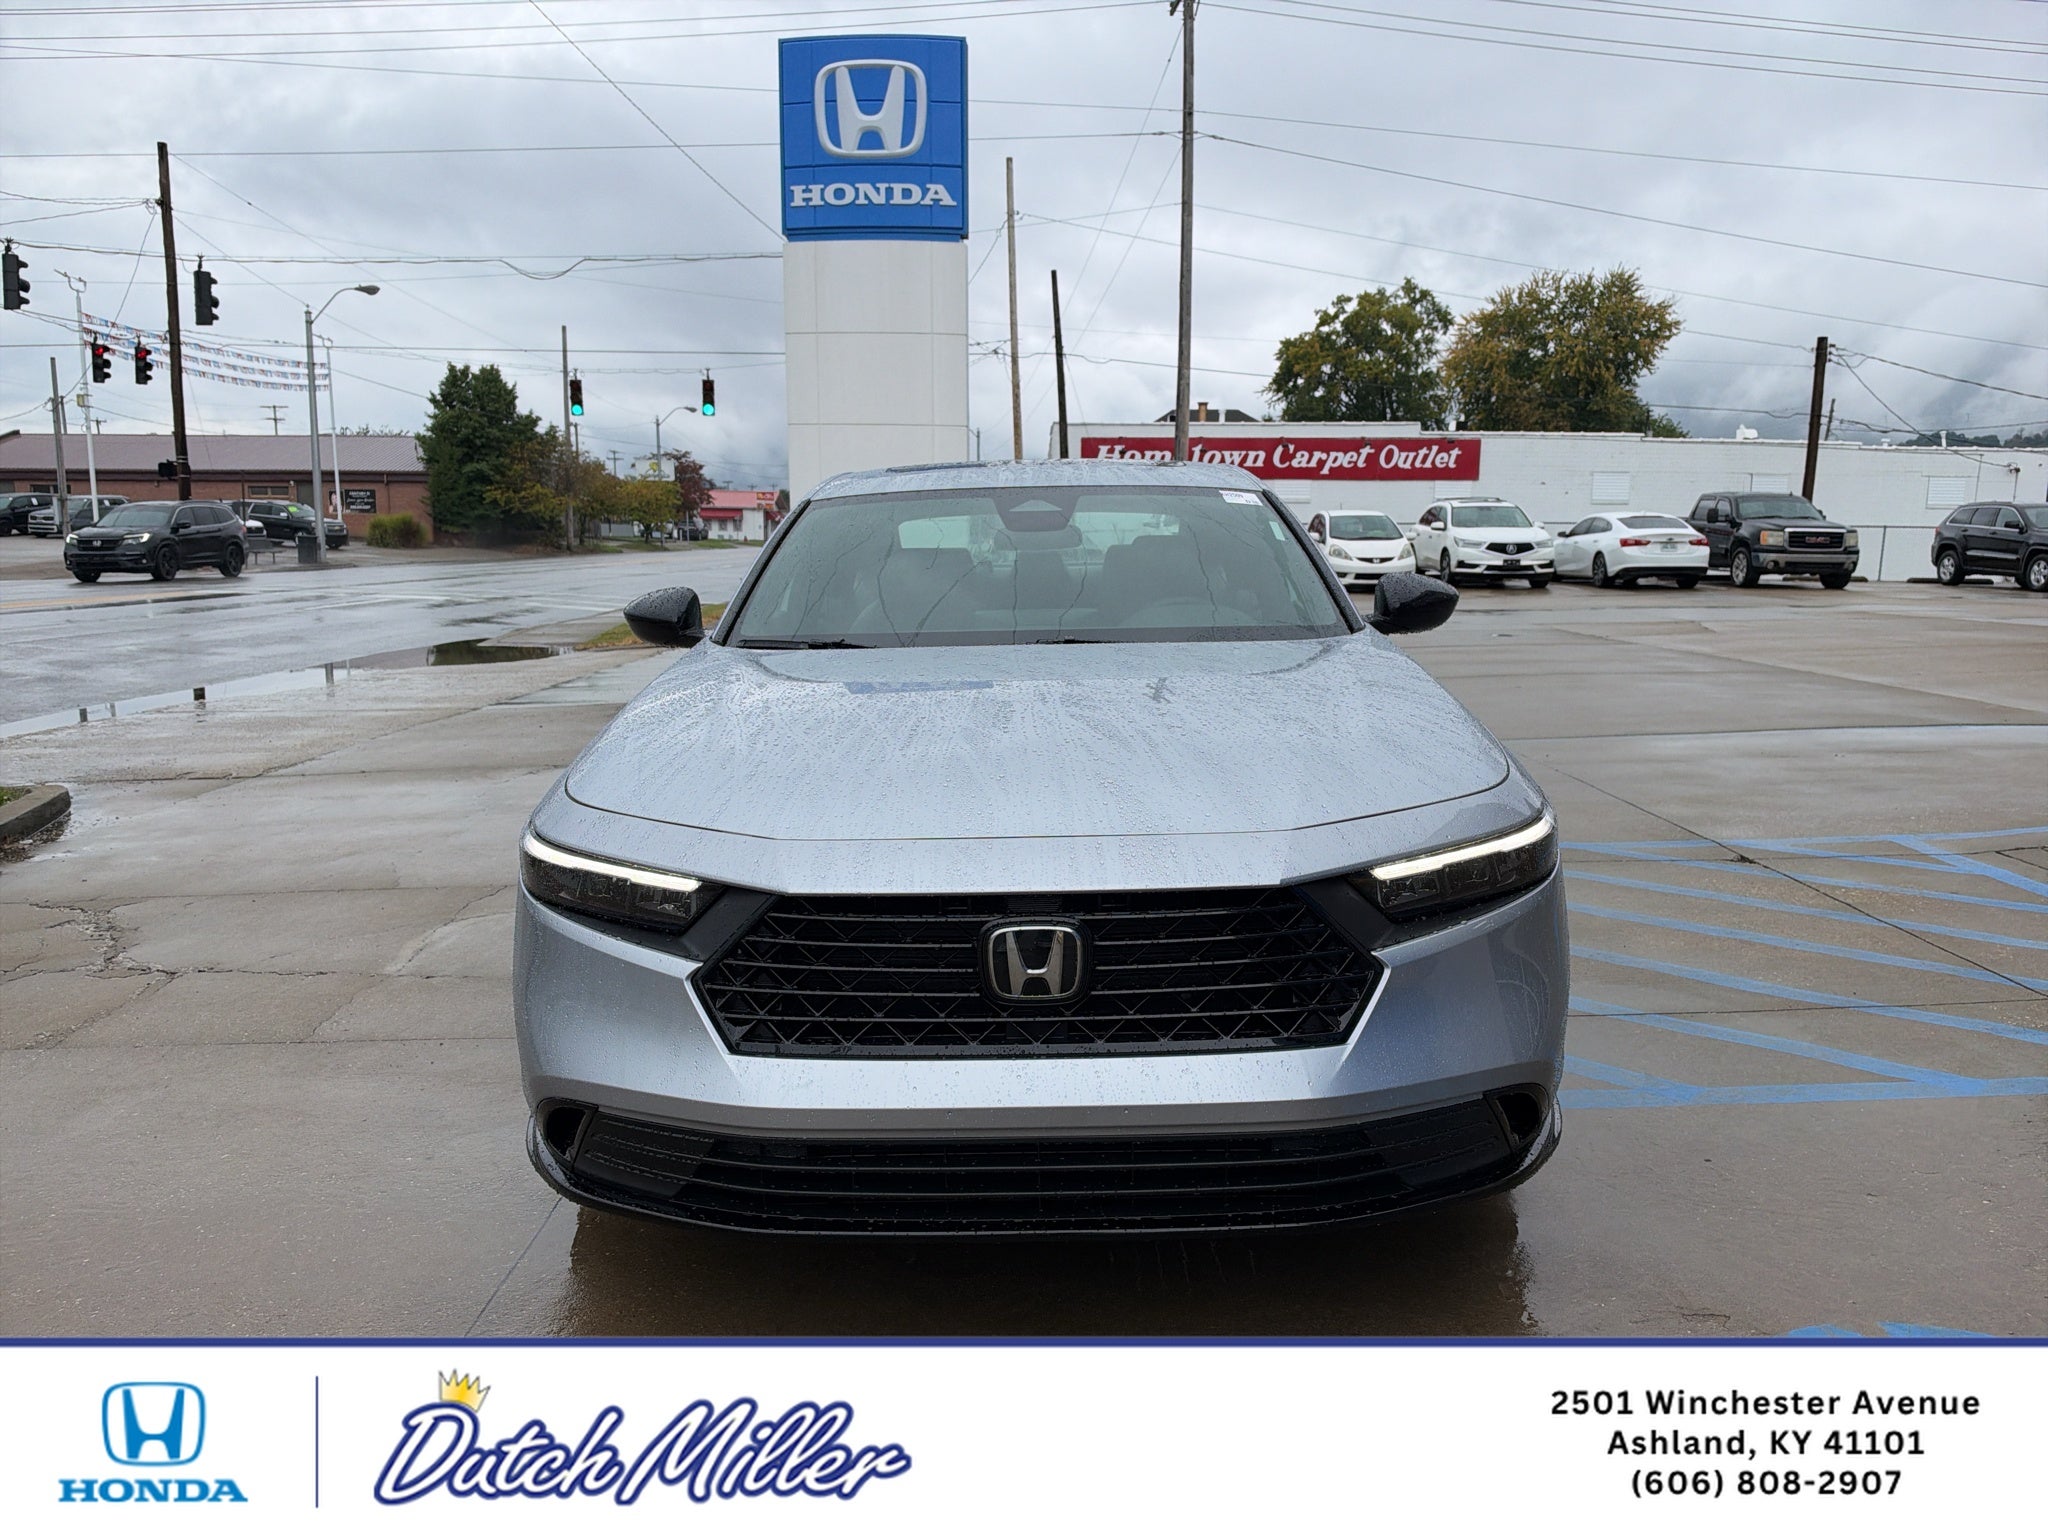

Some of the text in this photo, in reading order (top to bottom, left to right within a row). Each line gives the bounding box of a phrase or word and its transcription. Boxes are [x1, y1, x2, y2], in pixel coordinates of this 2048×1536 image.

[790, 182, 957, 207] HONDA
[1097, 443, 1462, 475] Homtown Carpet Outlet
